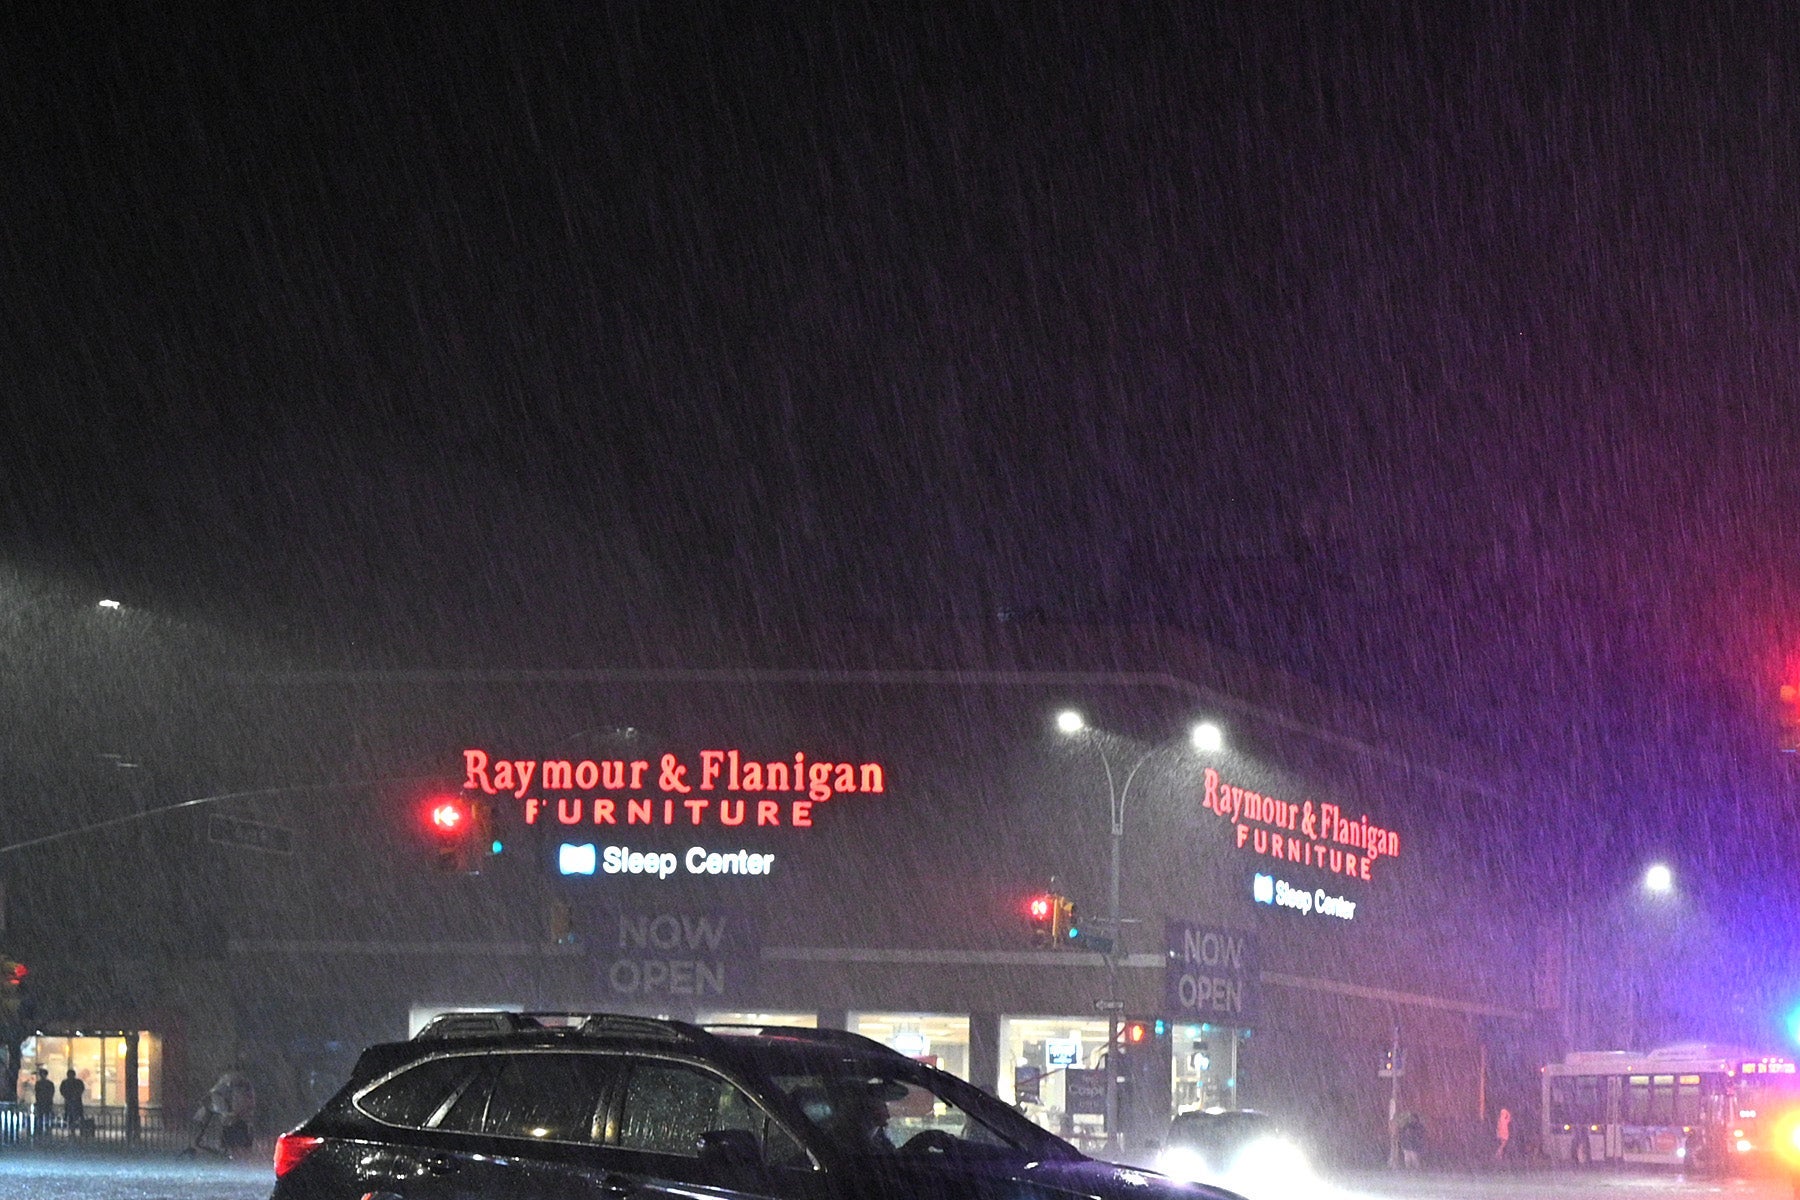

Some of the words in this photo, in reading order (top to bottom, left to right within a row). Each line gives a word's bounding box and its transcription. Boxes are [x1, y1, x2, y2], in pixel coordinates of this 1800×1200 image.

[463, 749, 649, 800] Raymour
[658, 752, 693, 794] &
[700, 749, 885, 803] Flanigan
[525, 798, 814, 827] FURNITURE
[1203, 768, 1299, 830] Raymour
[1301, 800, 1318, 836] &
[1320, 803, 1400, 859] Flanigan
[602, 845, 678, 880] Sleep
[685, 846, 775, 877] Center
[1236, 824, 1372, 881] FURNITURE
[1275, 880, 1313, 915] Sleep
[1314, 889, 1357, 920] Center
[616, 913, 729, 952] NOW
[1185, 929, 1244, 968] NOW
[610, 959, 726, 996] OPEN
[1178, 974, 1242, 1013] OPEN
